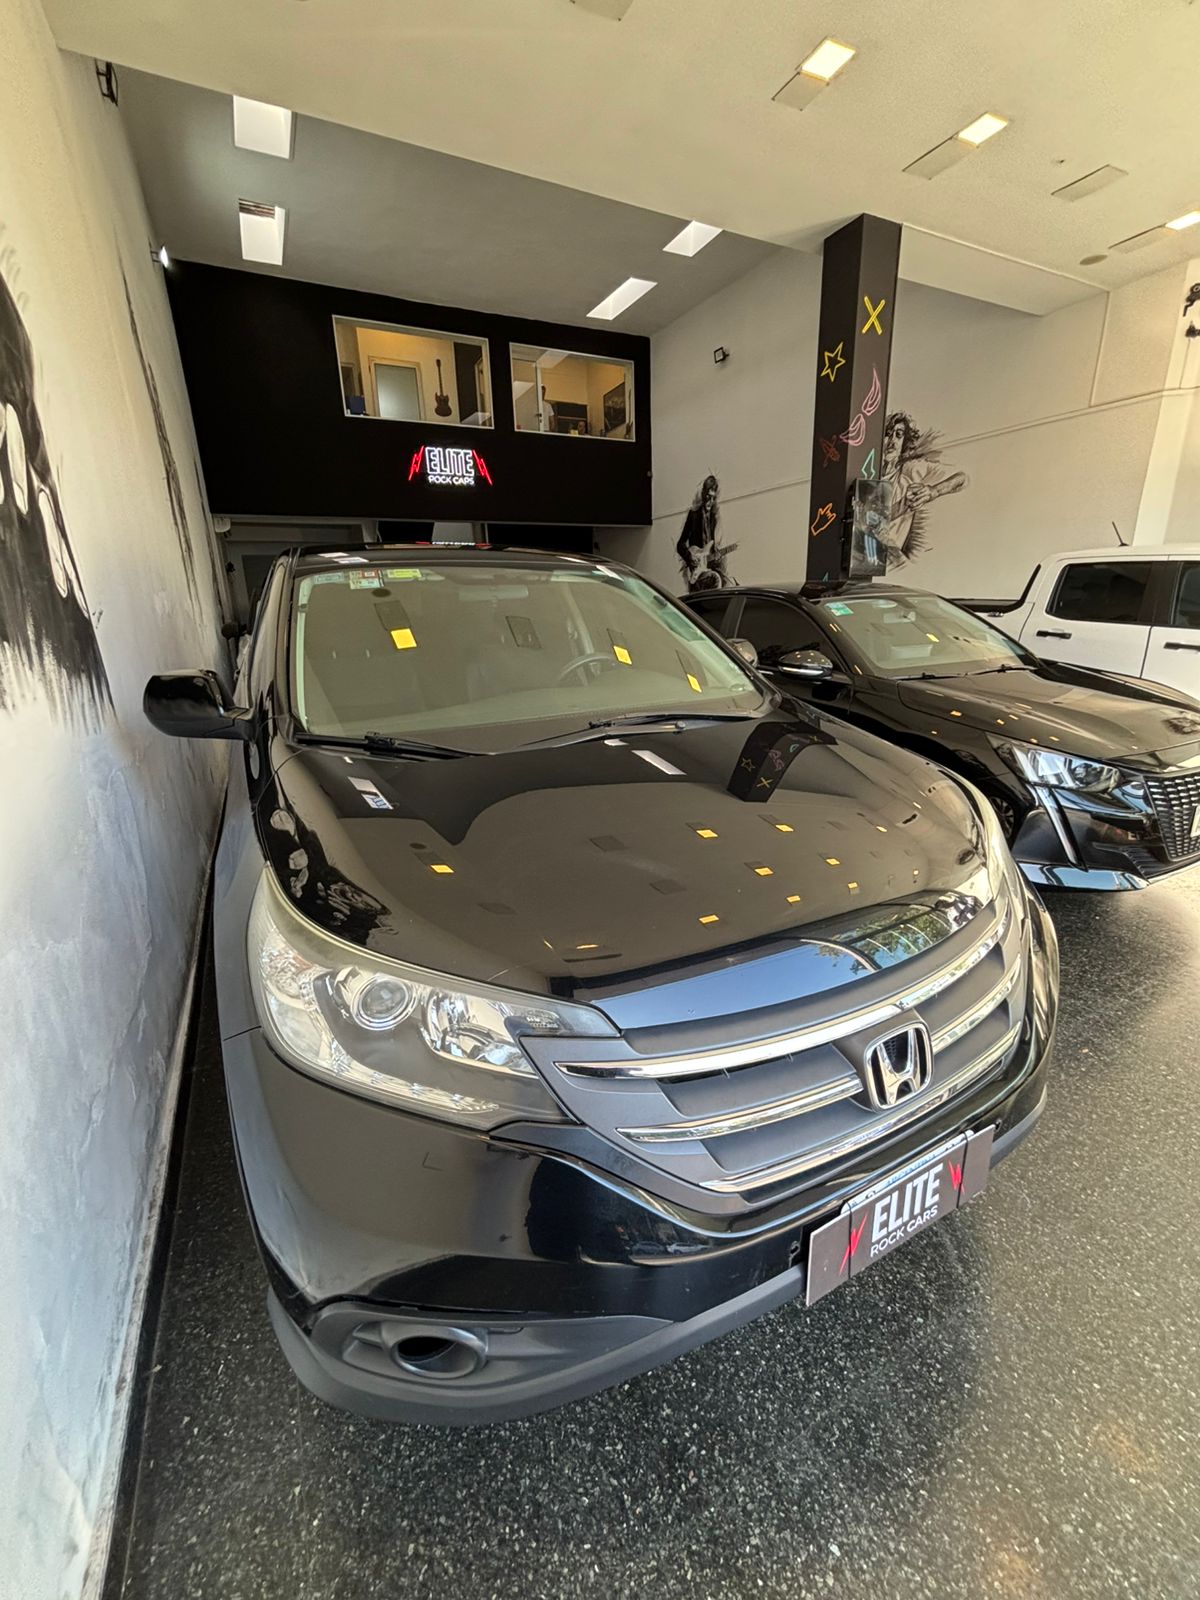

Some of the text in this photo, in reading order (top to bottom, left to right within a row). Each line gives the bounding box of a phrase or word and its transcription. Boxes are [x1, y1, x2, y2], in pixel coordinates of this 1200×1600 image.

[425, 447, 474, 476] ELITE
[871, 1163, 943, 1243] ELITE
[870, 1205, 938, 1258] ROCK CARS
